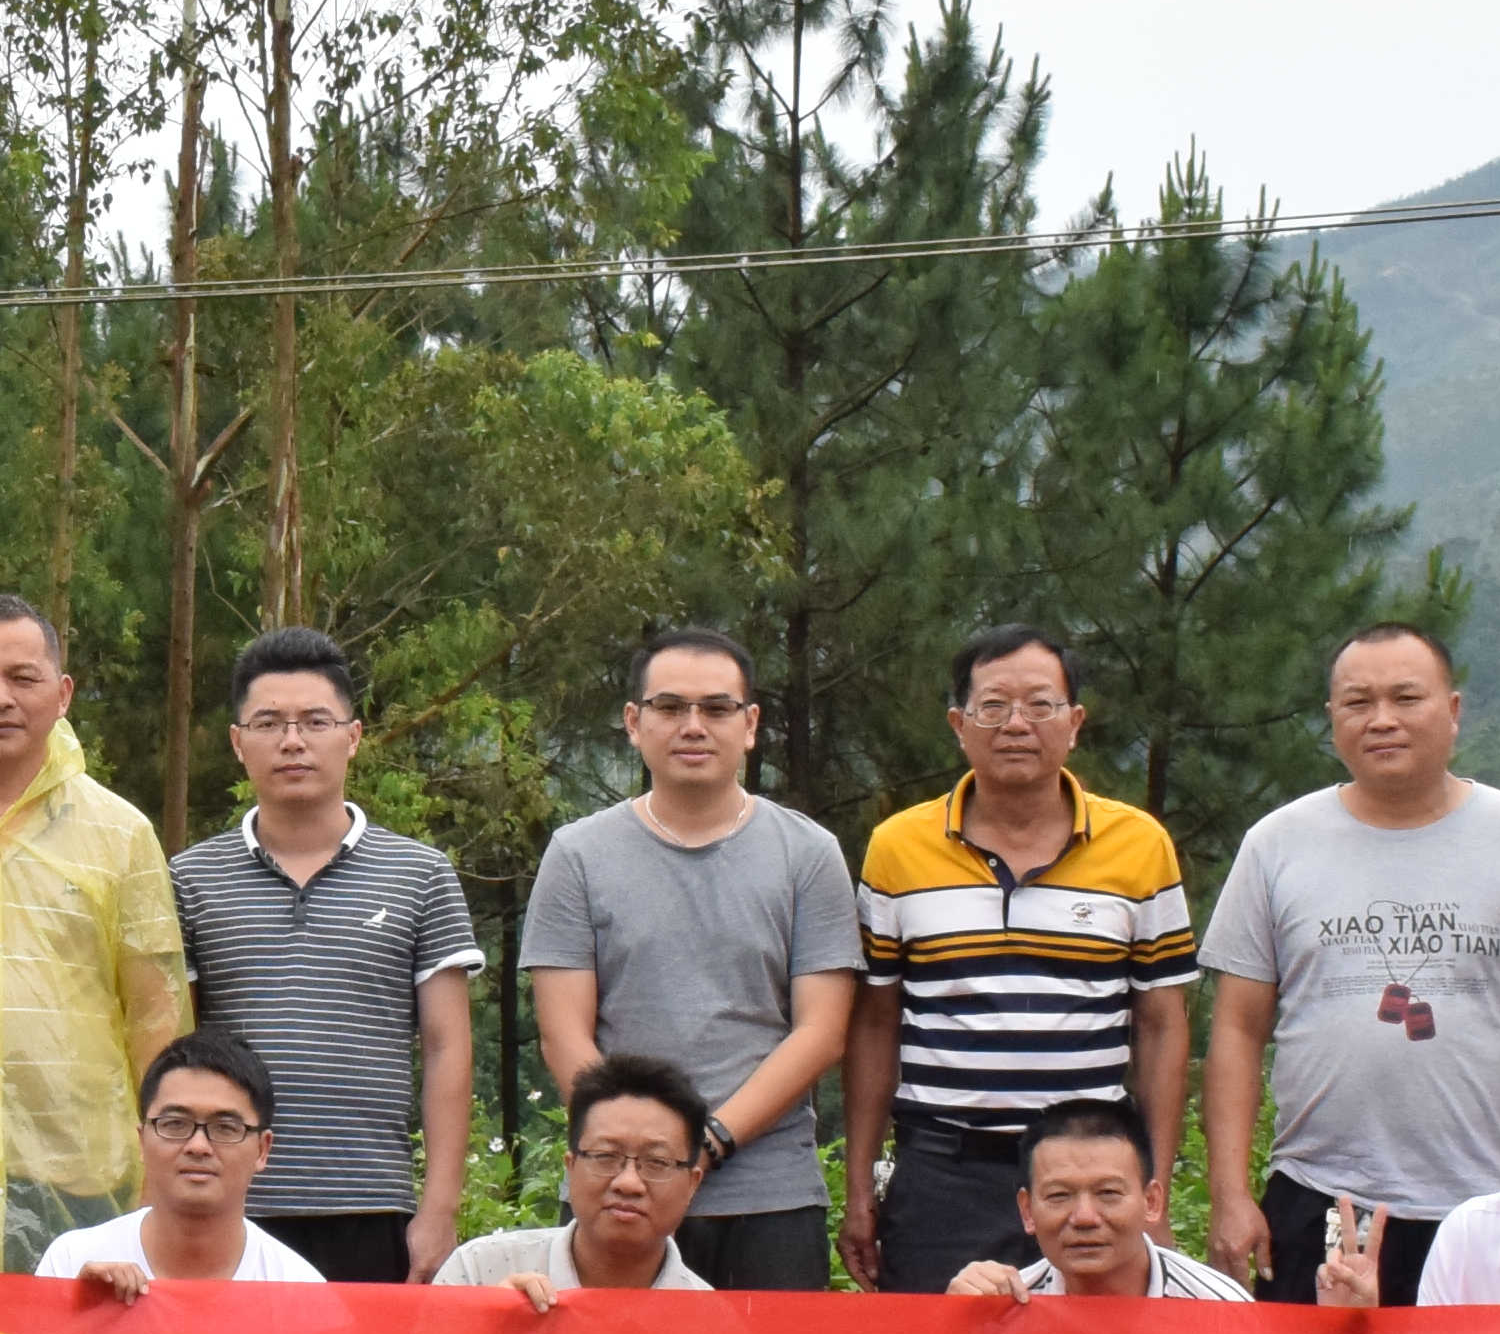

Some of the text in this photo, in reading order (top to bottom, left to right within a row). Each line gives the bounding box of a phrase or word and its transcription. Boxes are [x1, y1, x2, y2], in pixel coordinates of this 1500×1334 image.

[1318, 913, 1456, 938] XIAO TIAN
[1388, 933, 1500, 957] XIAO TIAN
